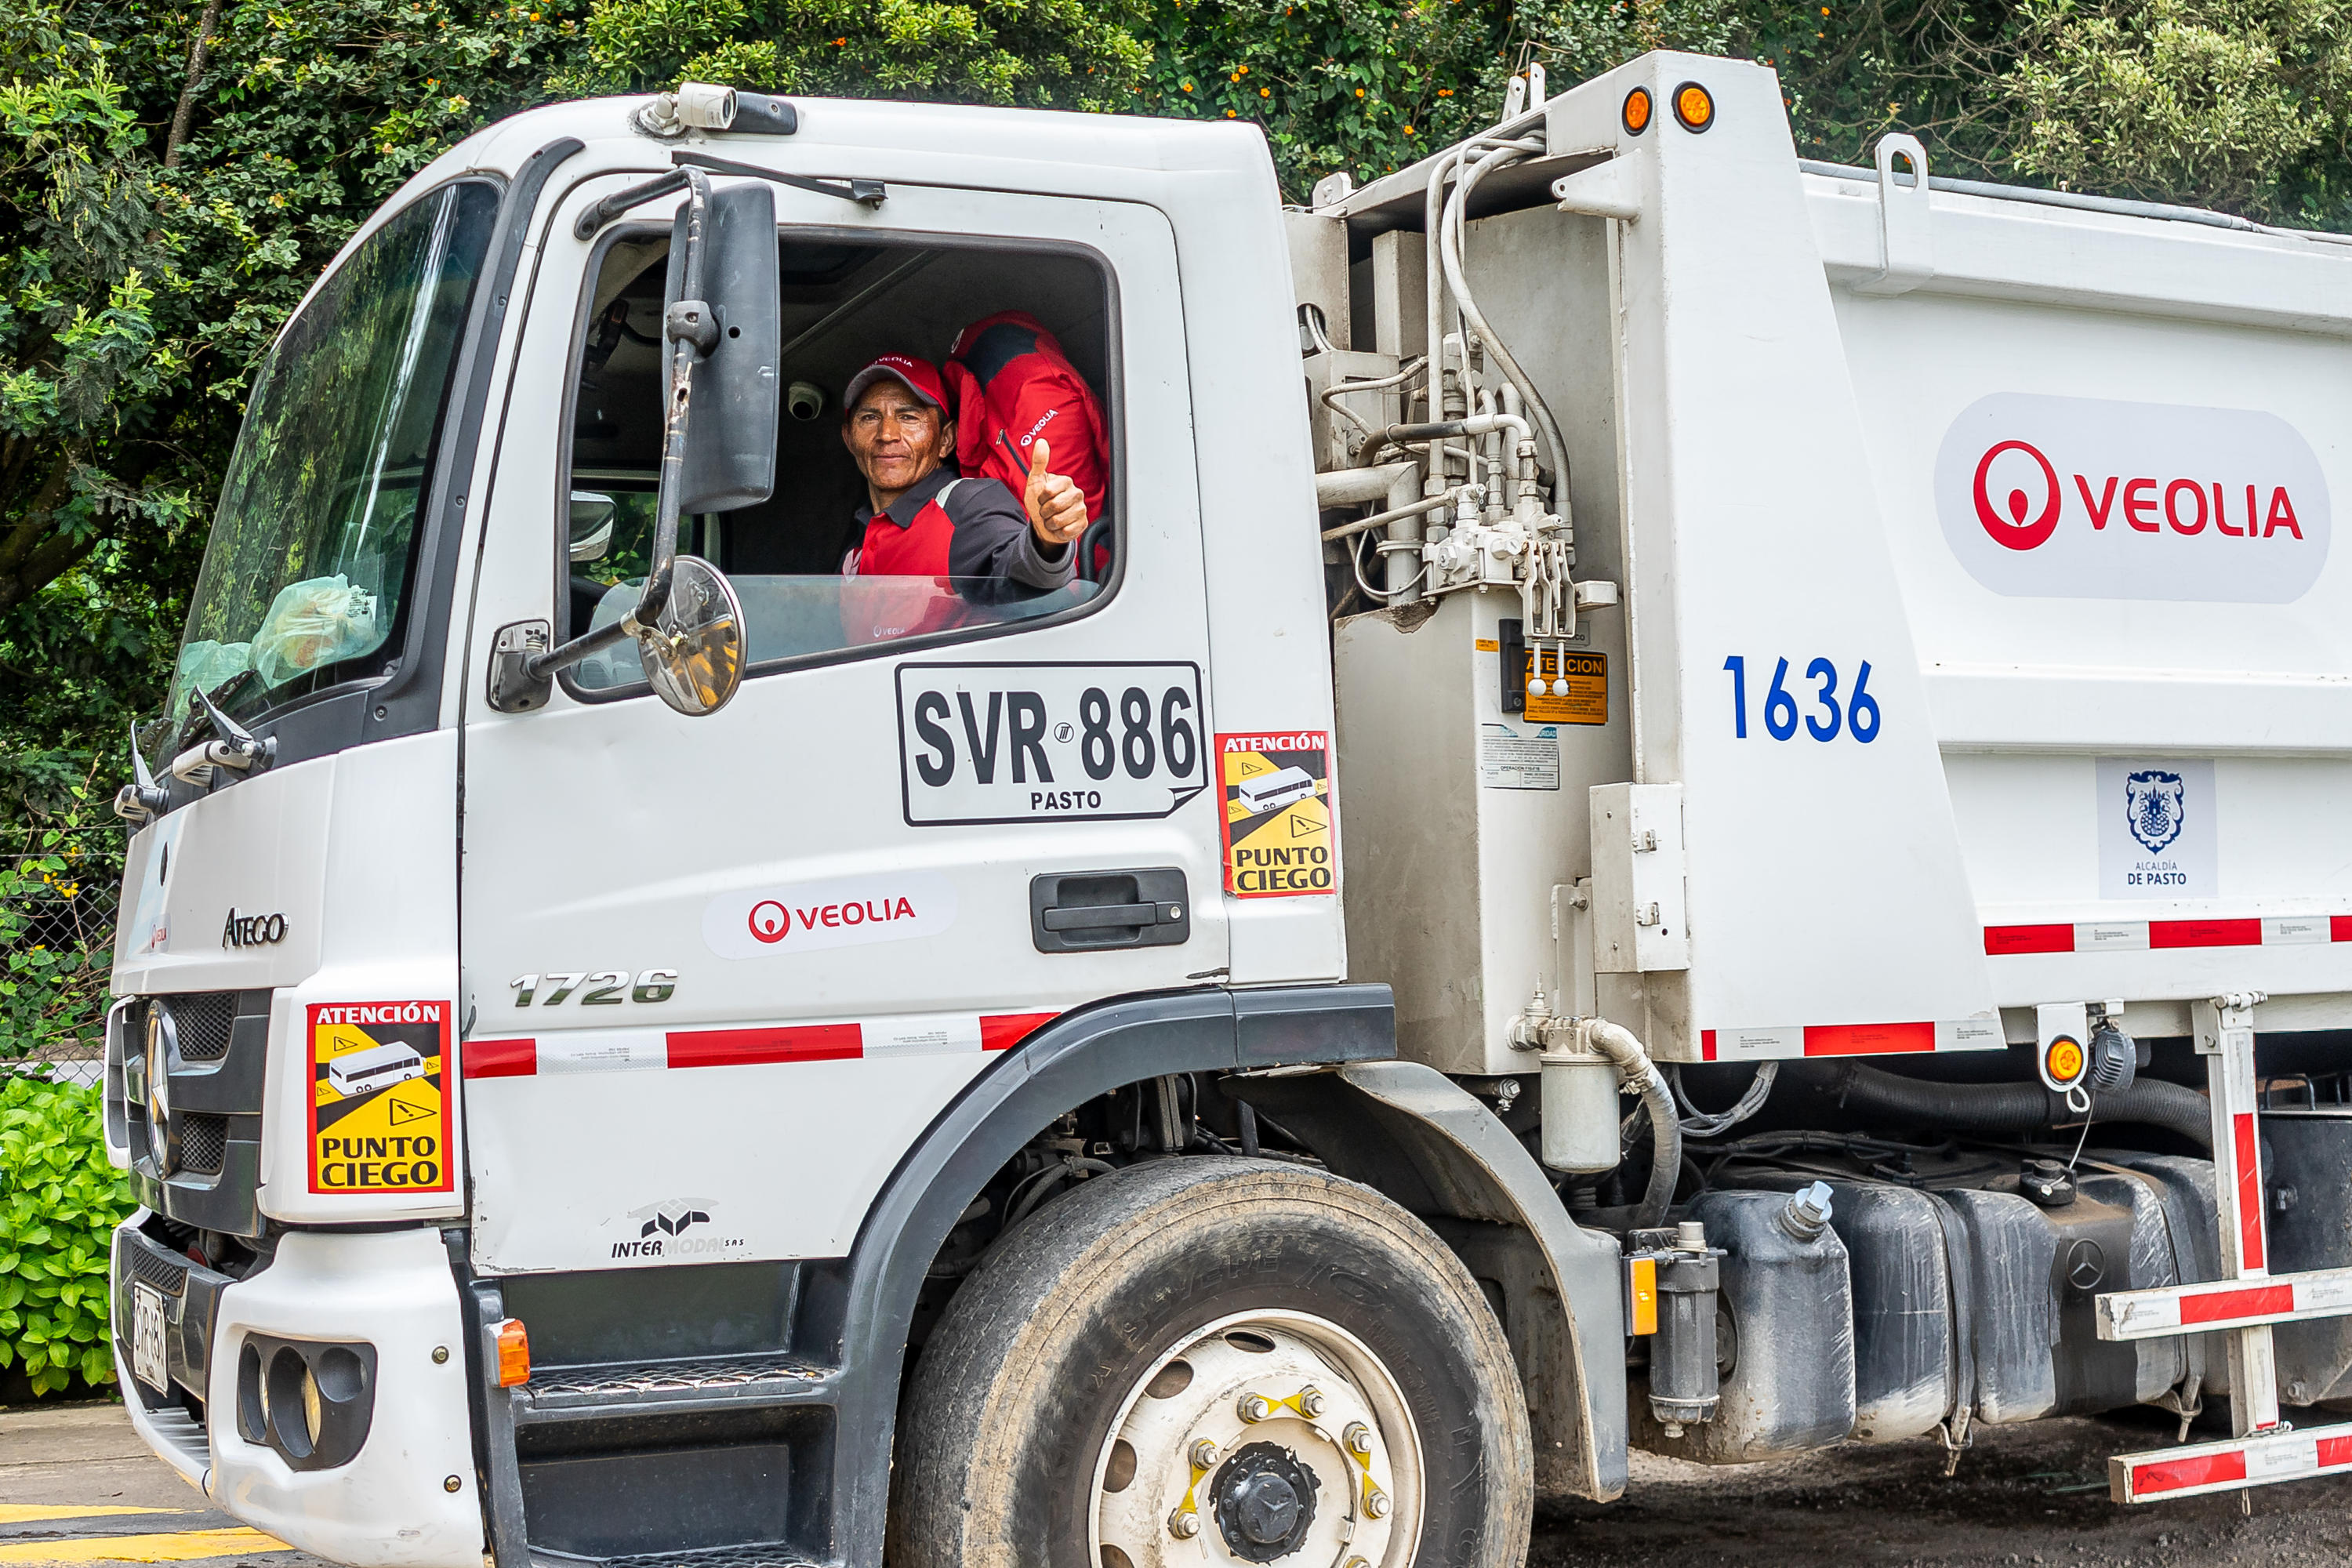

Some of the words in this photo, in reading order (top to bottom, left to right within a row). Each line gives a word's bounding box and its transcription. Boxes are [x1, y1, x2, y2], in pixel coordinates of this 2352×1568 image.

[1029, 408, 1059, 436] VEOLIA
[2072, 474, 2303, 540] VEOLIA
[1526, 655, 1602, 673] ATECION
[1722, 655, 1882, 744] 1636
[914, 691, 1054, 787] SVR
[1080, 687, 1196, 781] 886
[1224, 733, 1325, 752] ATENCIÓN
[1031, 790, 1101, 810] PASTO
[1236, 846, 1328, 867] PUNTO
[2136, 859, 2178, 871] ALCALDÍA
[1237, 867, 1331, 891] CIEGO
[2128, 873, 2143, 885] DE
[2147, 873, 2187, 885] PASTO
[796, 896, 916, 931] VEOLIA
[510, 969, 679, 1008] 1726
[316, 1002, 440, 1024] ATENCIÓN
[322, 1136, 436, 1159] PUNTO
[321, 1160, 438, 1187] CIEGO
